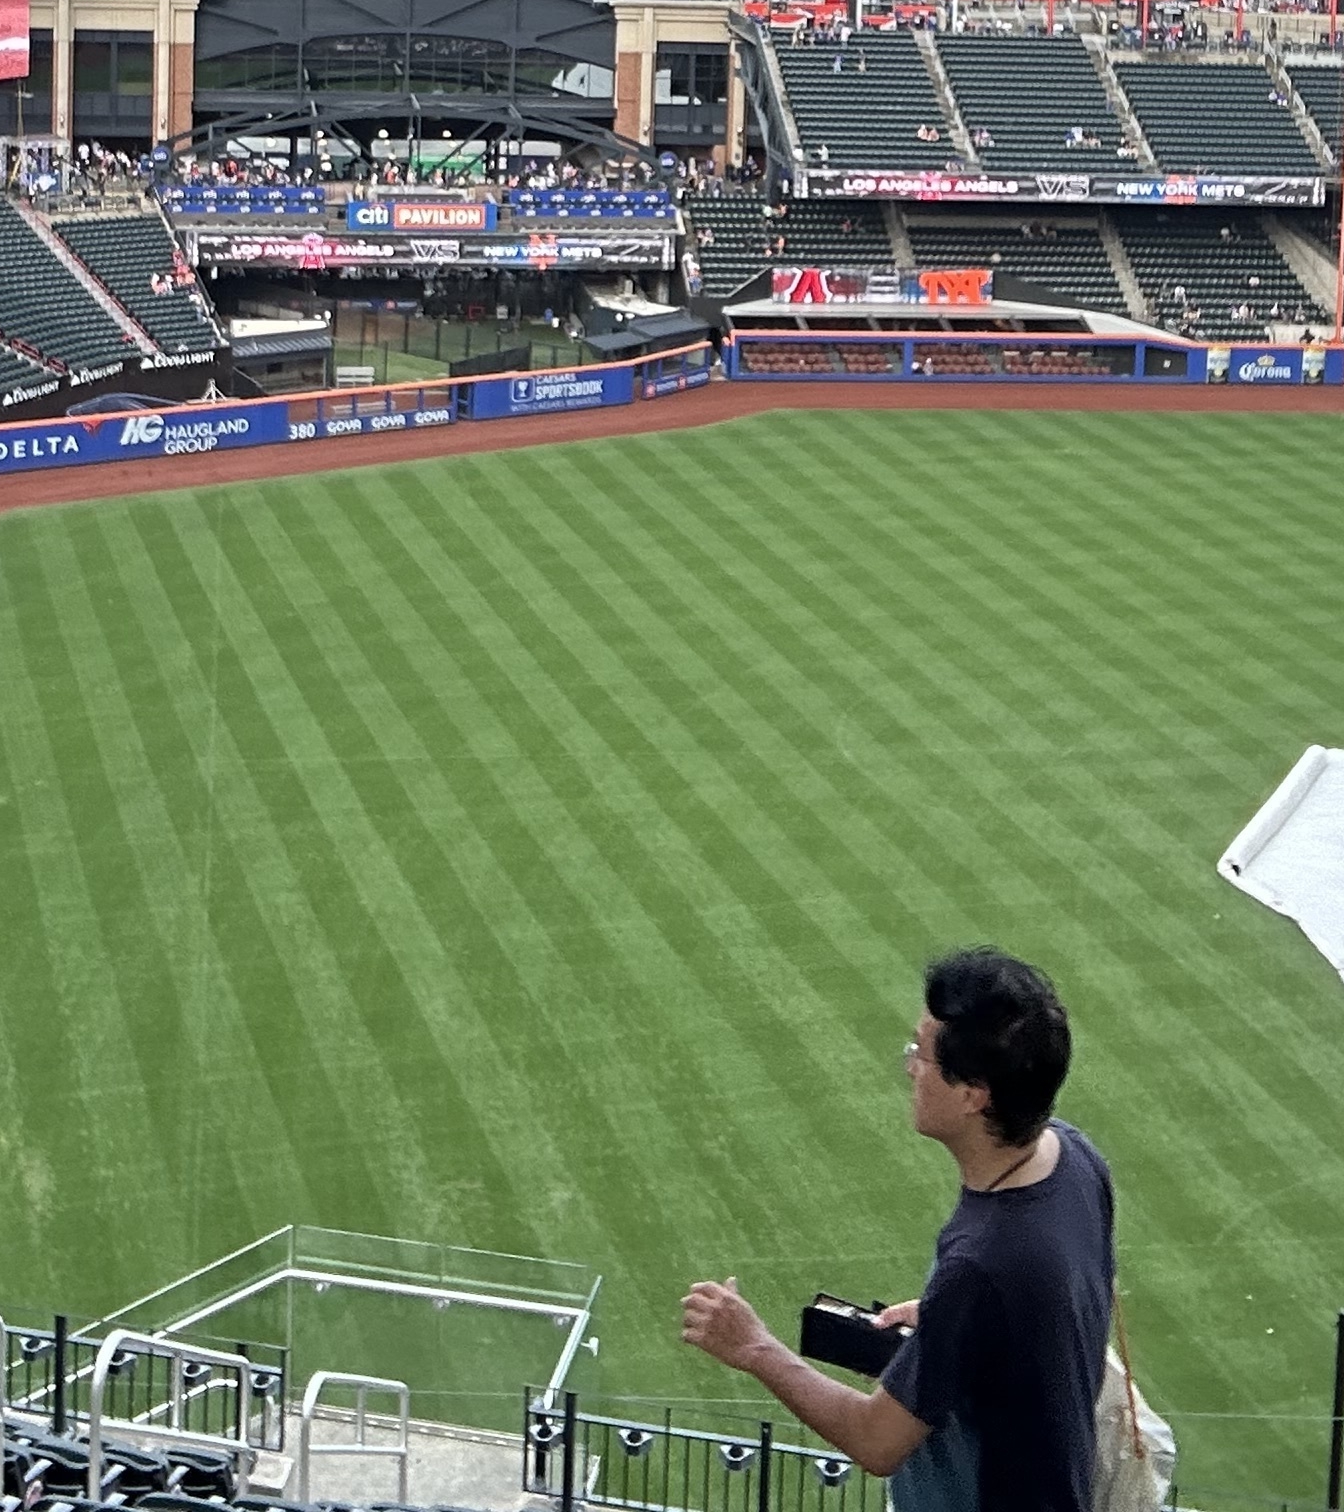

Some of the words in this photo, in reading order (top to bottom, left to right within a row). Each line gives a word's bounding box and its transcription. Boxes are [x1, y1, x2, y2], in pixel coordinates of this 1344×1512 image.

[843, 178, 876, 191] LOS
[878, 179, 952, 192] ANGELES
[955, 179, 1019, 193] ANGELS
[1116, 182, 1154, 196] NEW
[1157, 180, 1198, 196] YORK
[1201, 183, 1246, 198] METS
[356, 209, 389, 225] citi
[399, 209, 481, 226] PAVILION
[231, 245, 262, 257] LOS
[264, 245, 332, 257] ANGELES
[335, 245, 394, 257] ANGELS
[483, 245, 520, 258] NEW
[521, 246, 559, 258] YORK
[561, 246, 603, 258] METS
[1238, 362, 1292, 383] Corona
[535, 379, 604, 401] SPORTSBOOK
[164, 417, 250, 440] HAUGLAND
[288, 422, 316, 440] 380
[164, 438, 219, 456] GROUP
